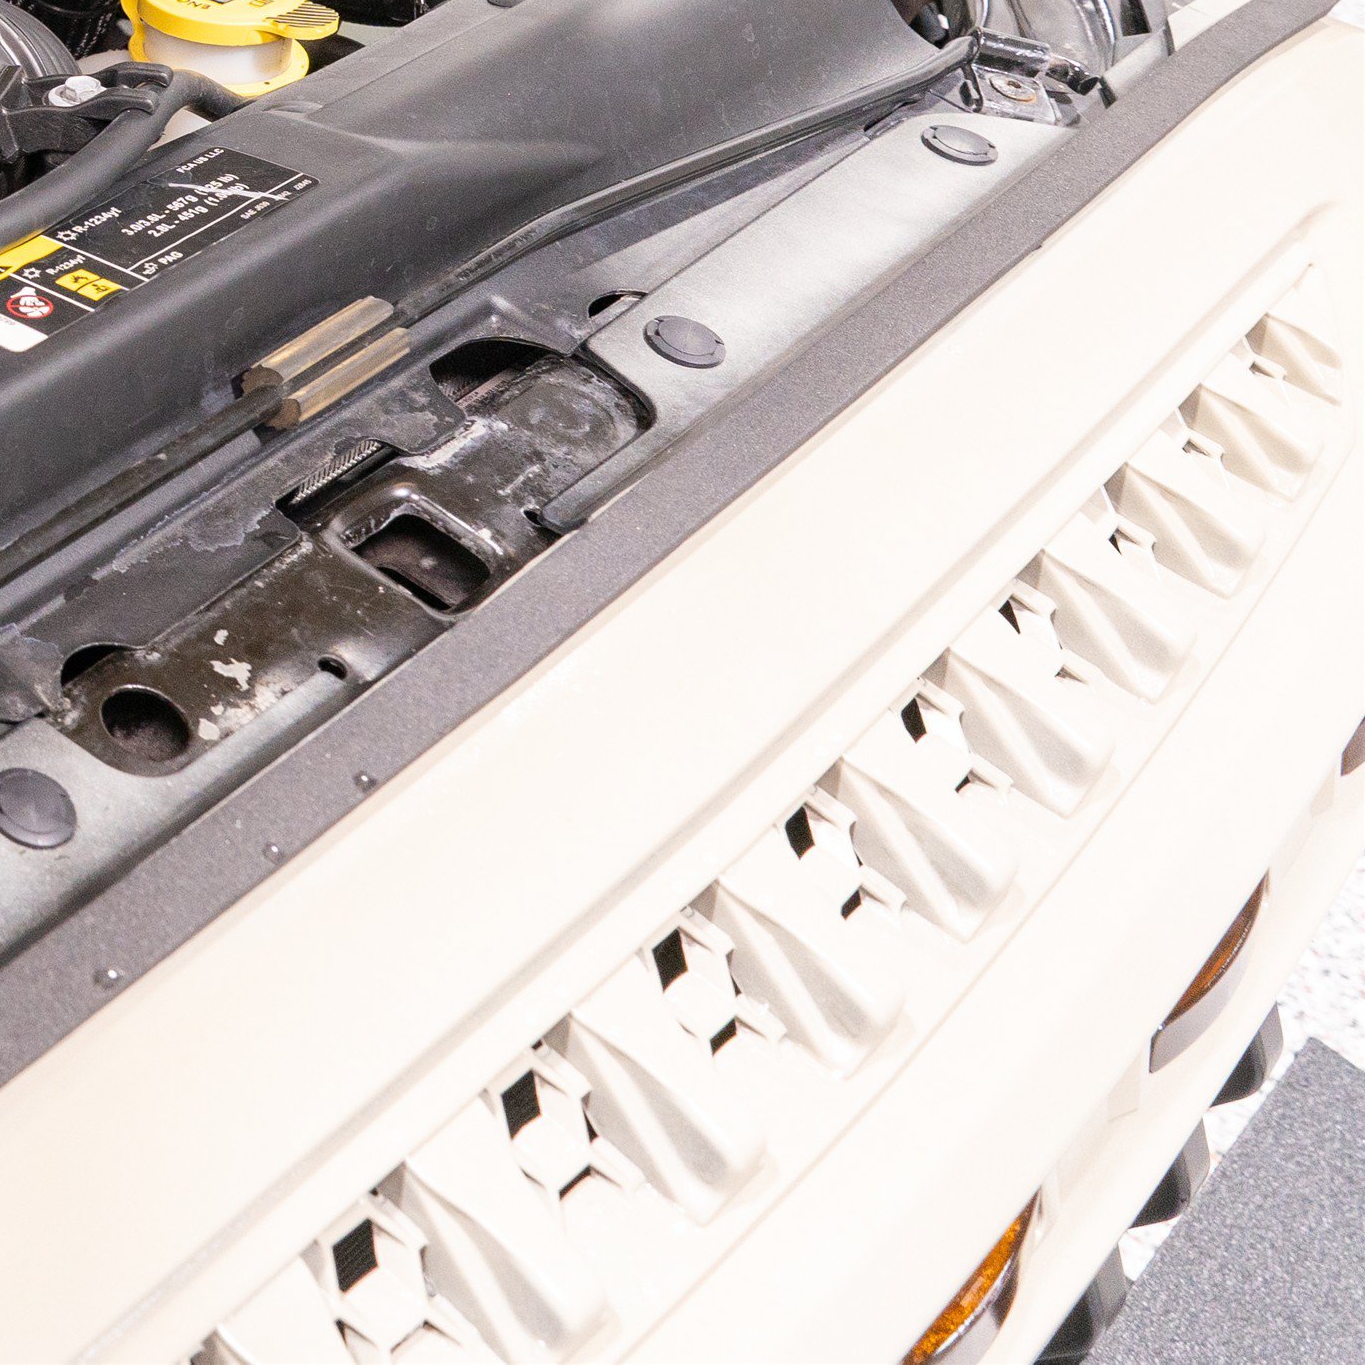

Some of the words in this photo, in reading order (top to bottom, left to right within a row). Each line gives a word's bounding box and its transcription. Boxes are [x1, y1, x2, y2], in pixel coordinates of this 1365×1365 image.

[176, 163, 194, 174] FCA
[204, 148, 225, 160] LLC
[74, 207, 122, 236] R-1234yf
[121, 208, 167, 236] 3.0/3.6L
[167, 195, 199, 212] 567g
[177, 206, 209, 223] 451g
[158, 250, 184, 266] PAG
